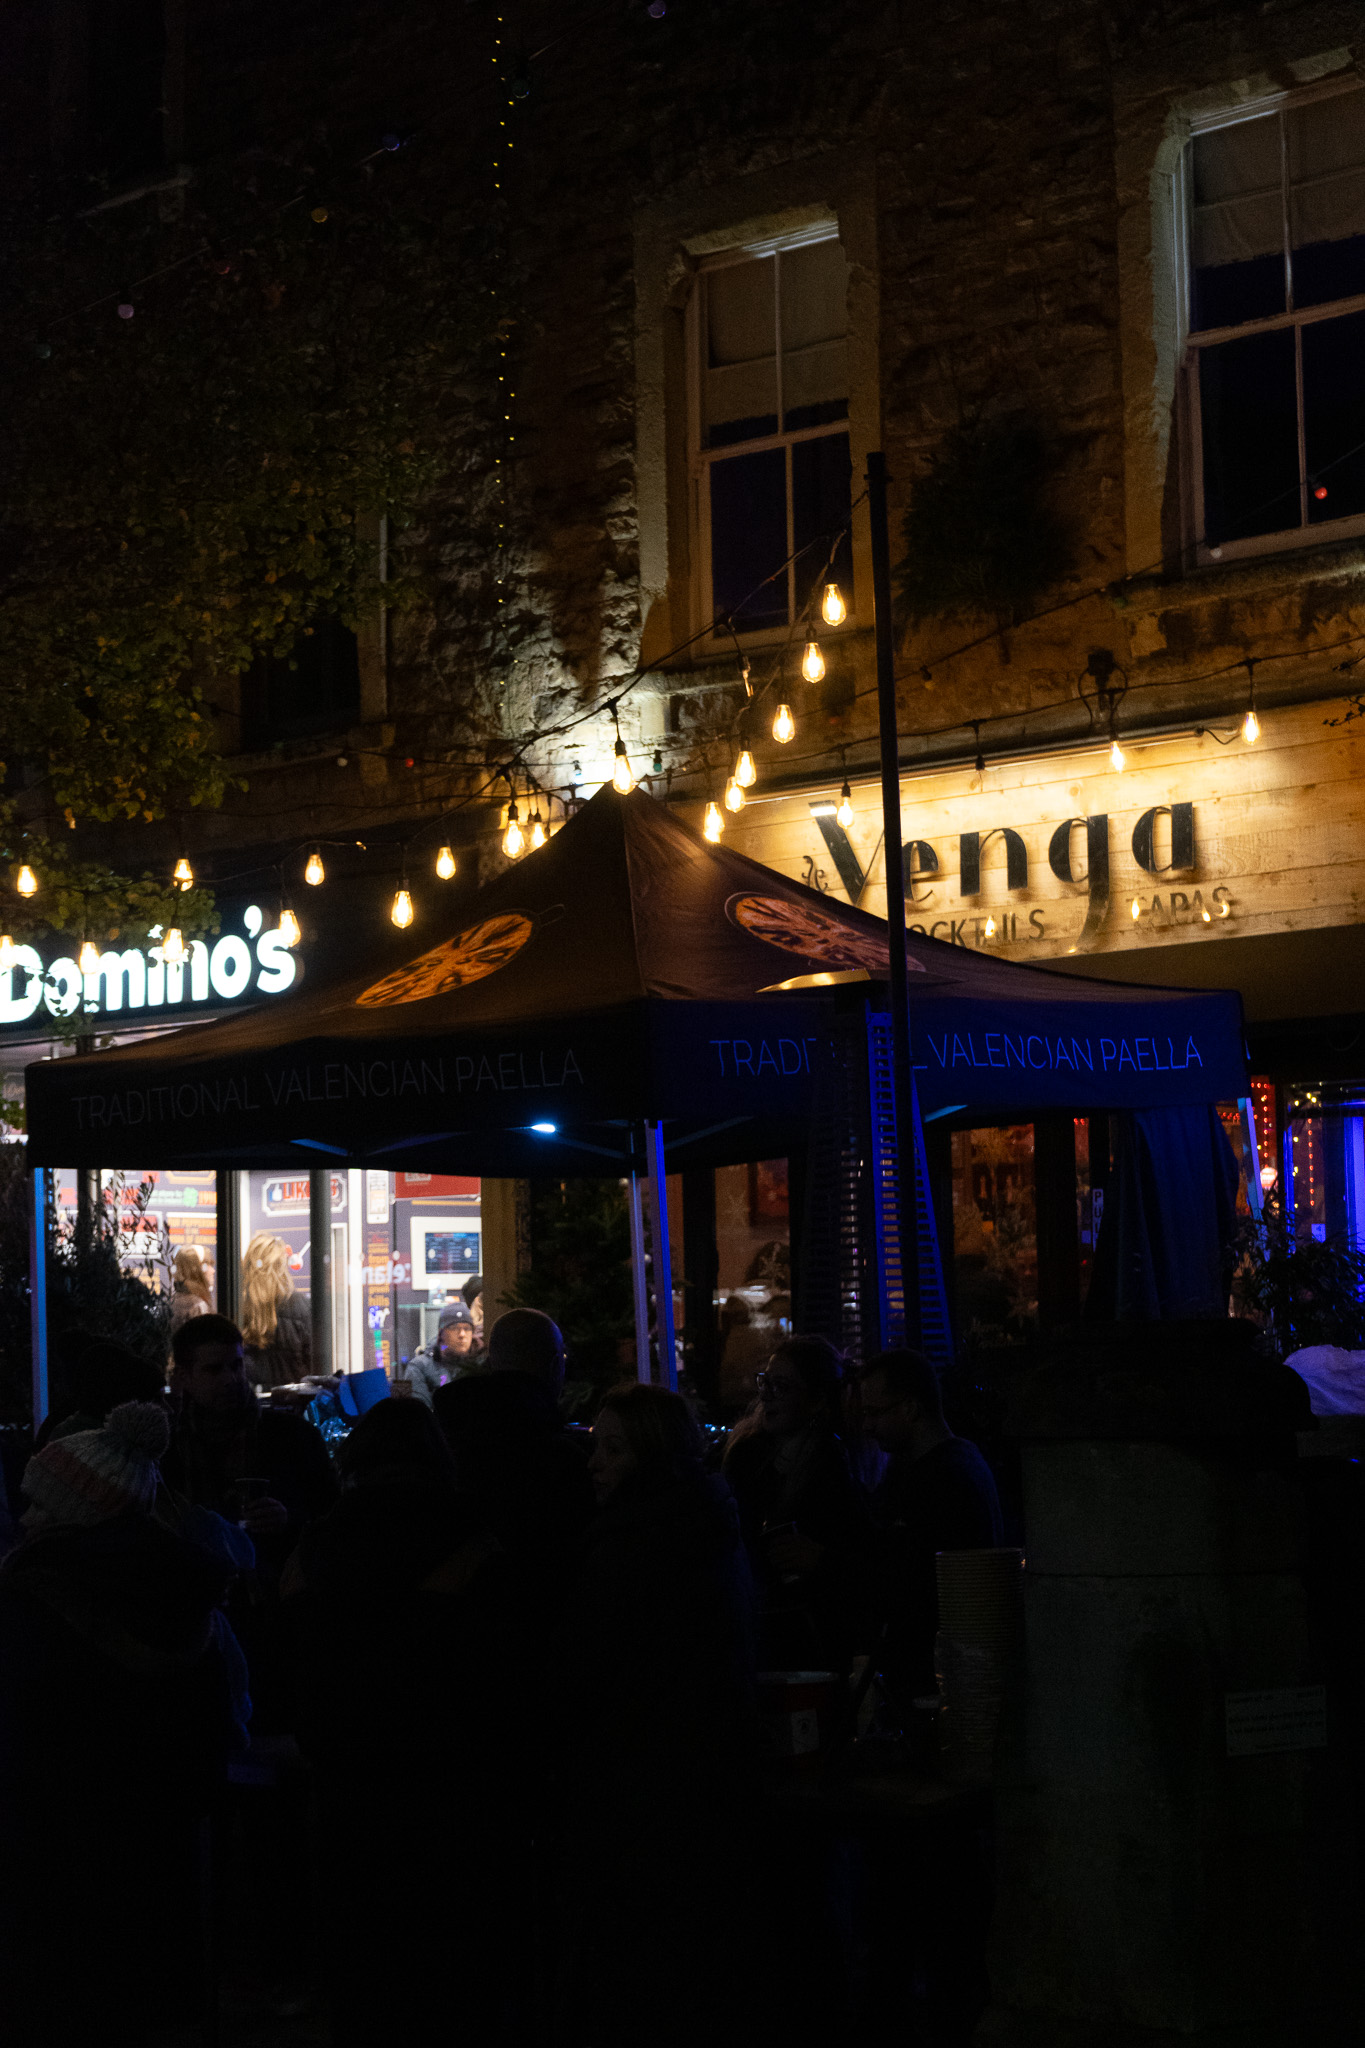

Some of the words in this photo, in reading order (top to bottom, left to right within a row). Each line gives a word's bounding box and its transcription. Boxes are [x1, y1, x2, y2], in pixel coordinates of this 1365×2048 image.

[808, 800, 1195, 945] Venga
[909, 908, 1046, 948] CKTILS
[0, 905, 296, 1023] Domino's
[928, 1032, 1095, 1071] VALENCIAN
[1101, 1035, 1203, 1072] PAELLA
[73, 1076, 260, 1131] TRADITIONAL
[265, 1056, 447, 1106] VALENCIAN
[456, 1048, 584, 1092] PAELLA
[282, 1180, 311, 1200] LIK
